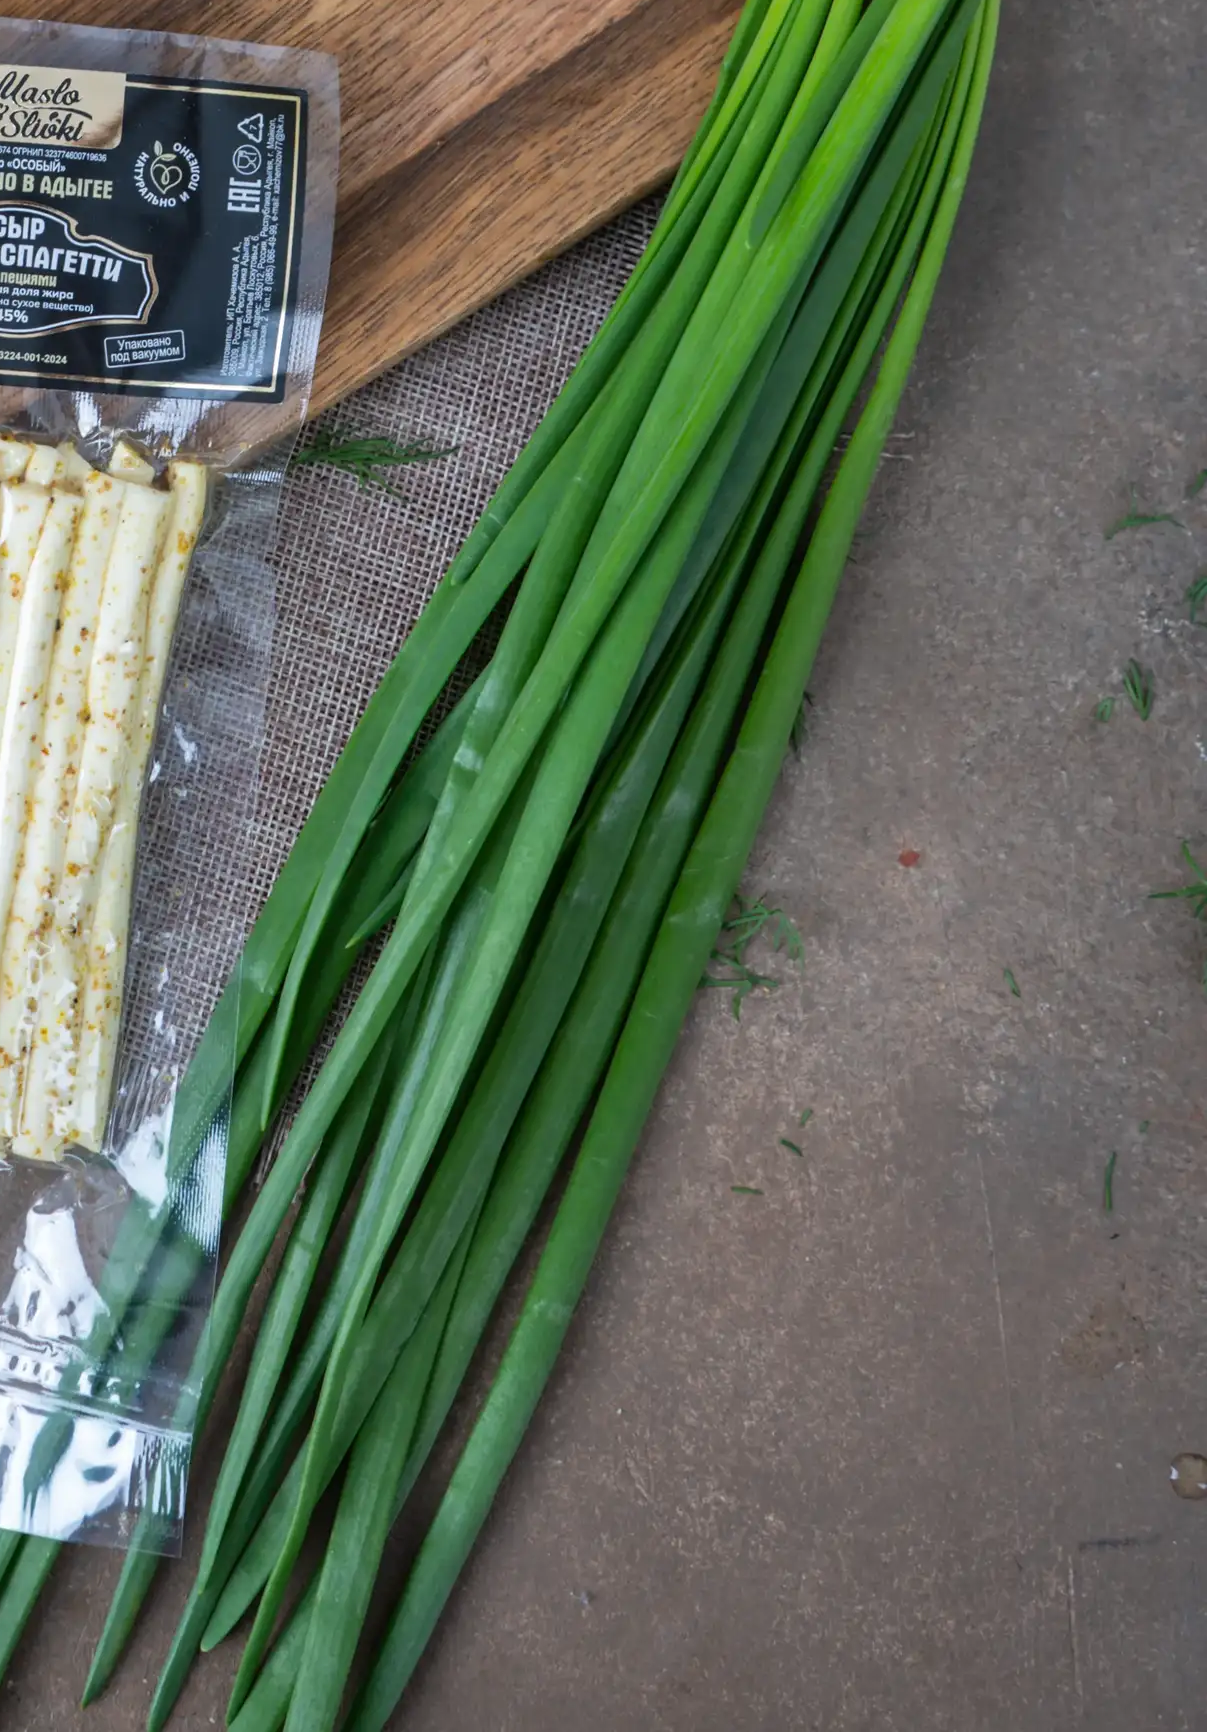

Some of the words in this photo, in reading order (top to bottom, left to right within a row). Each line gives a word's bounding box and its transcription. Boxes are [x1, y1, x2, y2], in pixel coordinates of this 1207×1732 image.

[12, 146, 43, 157] ОГРНИП
[7, 158, 66, 173] «ОСОБЫЙ»
[173, 142, 200, 191] ПОЛЕЗНО
[22, 173, 35, 193] В
[39, 175, 113, 200] АДЫГЕЕ
[133, 151, 177, 208] НАТУРАЛЬНО
[179, 190, 190, 202] И
[259, 191, 272, 236] Республика
[240, 235, 251, 265] Адыгея,
[227, 264, 239, 305] Хачемизов
[265, 265, 275, 284] (985)
[11, 286, 40, 297] доля
[41, 288, 74, 301] жира
[235, 268, 249, 312] Республика
[12, 299, 40, 311] сухое
[43, 301, 94, 314] вещество)
[225, 308, 234, 320] ИП
[243, 292, 254, 323] Братьев
[231, 315, 243, 344] Россия,
[117, 335, 171, 351] Упаковано
[110, 352, 130, 364] под
[132, 346, 180, 362] вакуумом
